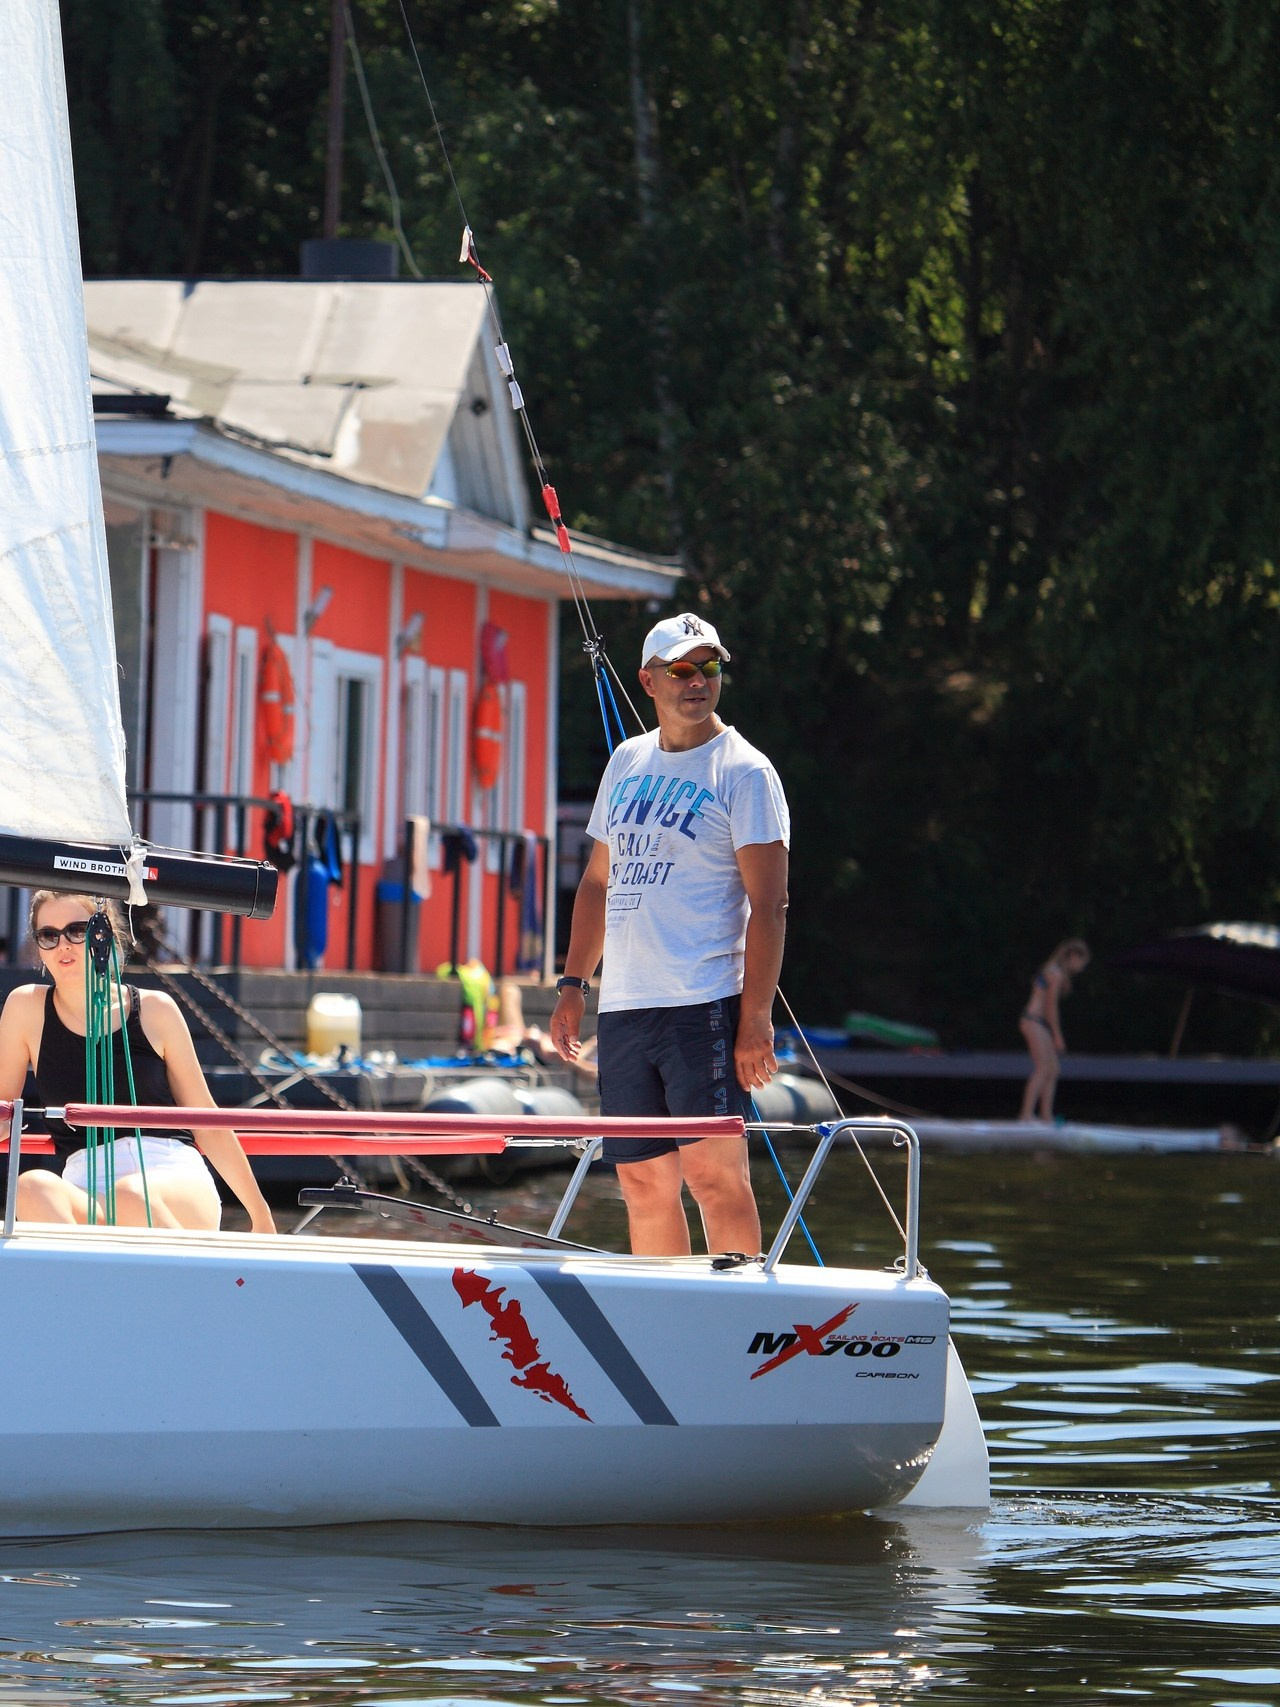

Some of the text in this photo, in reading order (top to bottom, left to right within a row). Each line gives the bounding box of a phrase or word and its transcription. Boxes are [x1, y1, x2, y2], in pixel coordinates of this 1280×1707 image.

[59, 860, 128, 875] WIND BROTH
[621, 862, 676, 885] COAST
[710, 1000, 722, 1031] FIL
[712, 1039, 726, 1080] FILA
[714, 1088, 728, 1114] ILA
[870, 1335, 905, 1343] BOATS
[855, 1371, 920, 1379] CARBON
